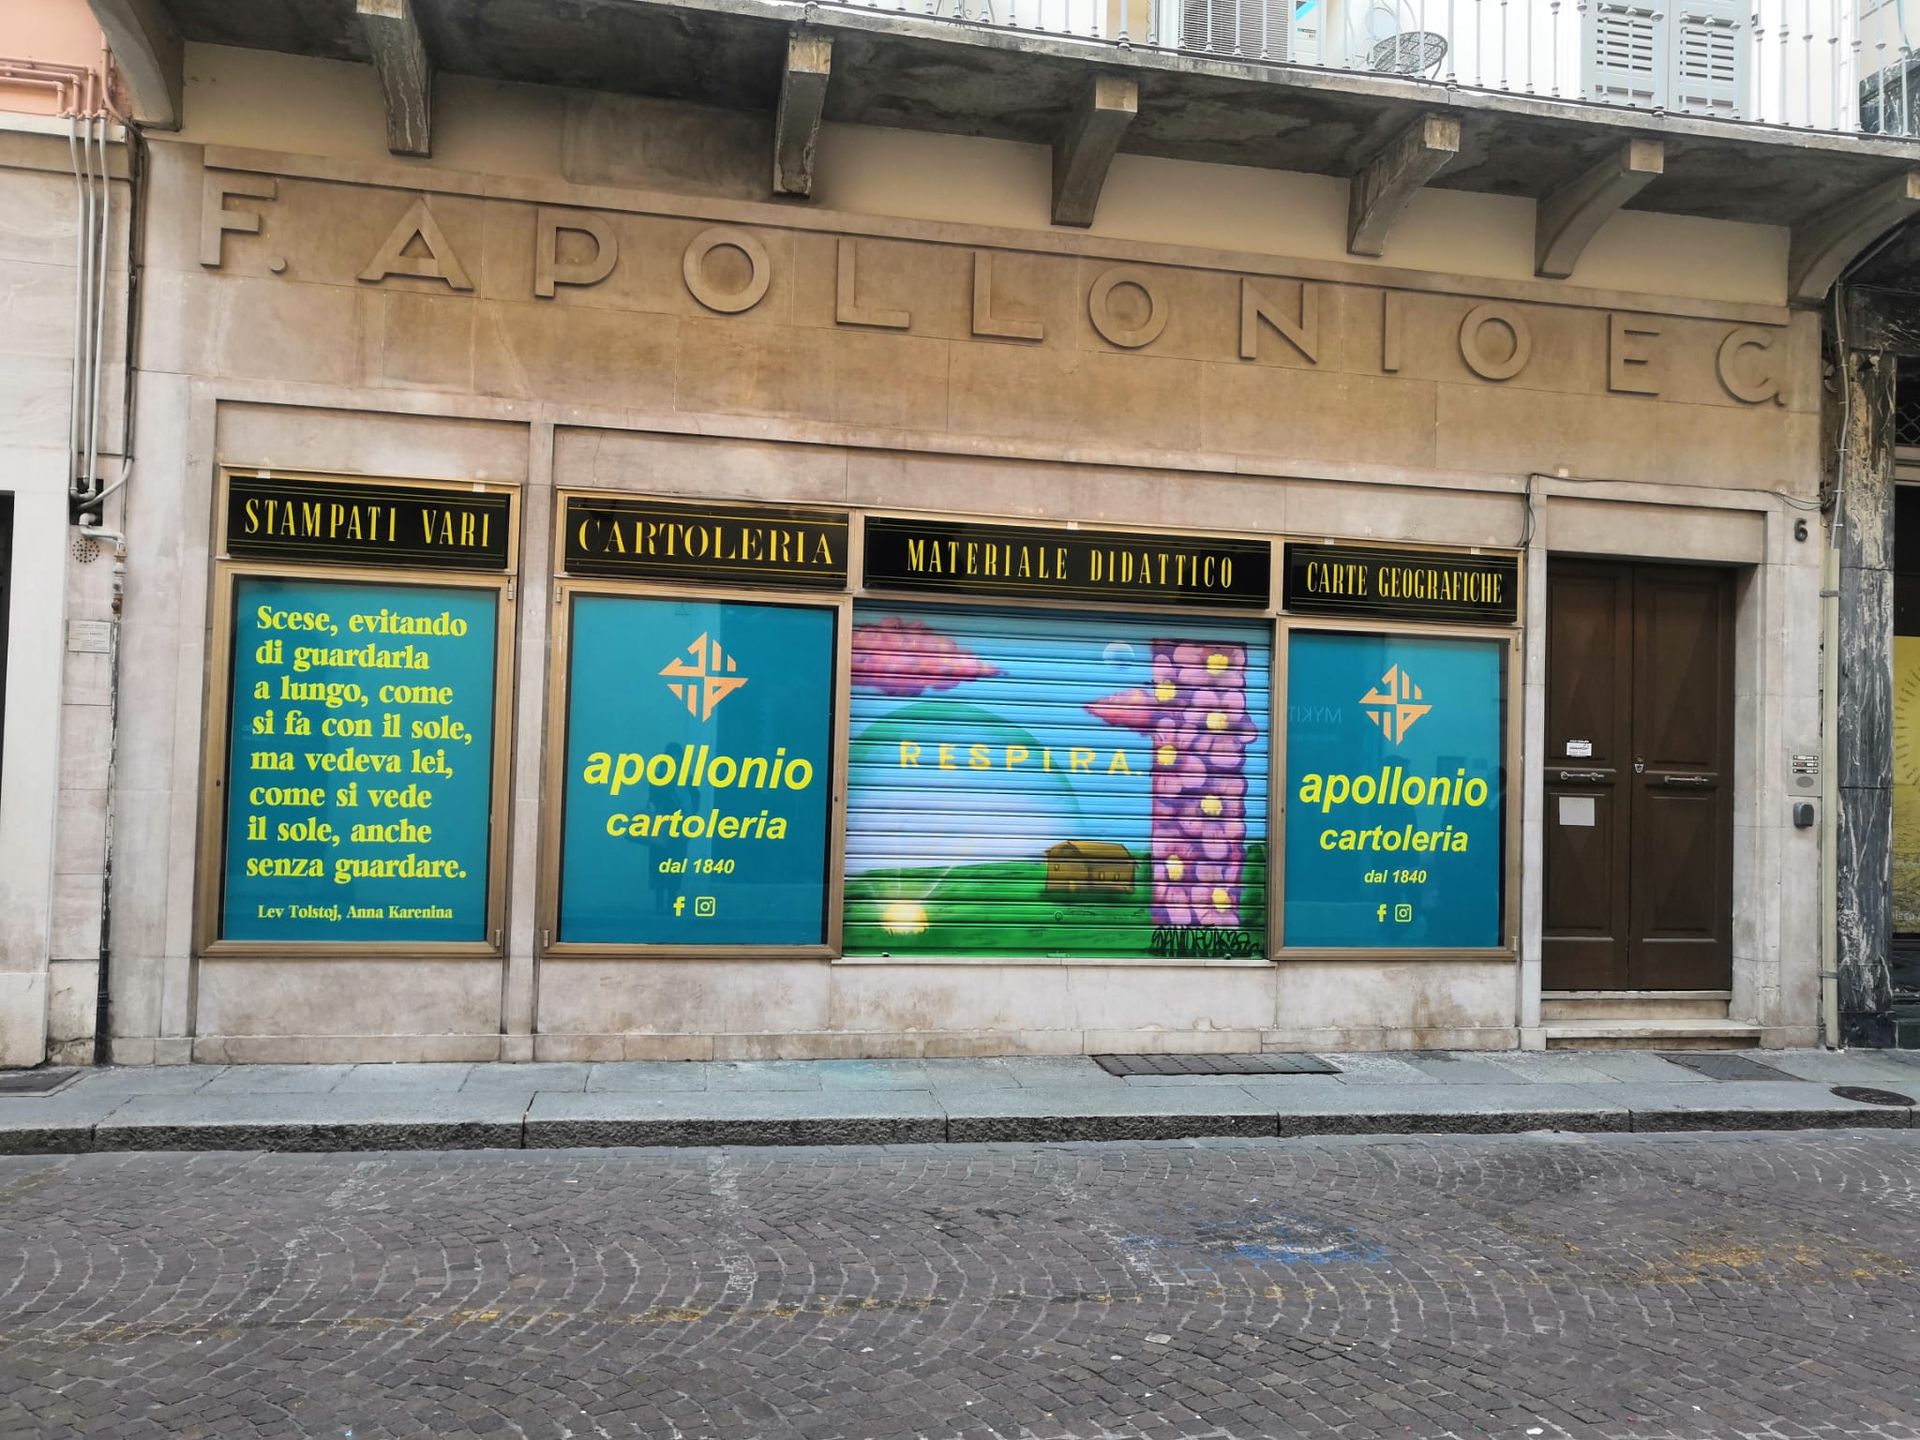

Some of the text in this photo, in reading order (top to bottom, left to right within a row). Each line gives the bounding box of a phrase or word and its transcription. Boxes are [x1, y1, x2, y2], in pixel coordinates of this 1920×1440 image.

[200, 171, 288, 276] F.
[245, 499, 489, 548] STAMPATI VARI
[1794, 518, 1808, 542] 6
[578, 518, 834, 565] CARTOLERIA
[908, 538, 1232, 588] MATERIALE DIDATTICO
[1307, 561, 1504, 604] CARTE GEOGRAFICHE
[257, 605, 468, 637] Scese, evitando
[255, 639, 430, 673] di guardarla
[254, 675, 453, 708] a lungo, come
[252, 709, 473, 744] si fa con il sole,
[251, 747, 453, 778] ma vedeva lei,
[583, 744, 814, 796] apollonio
[899, 741, 1143, 776] RESPIRA.
[249, 782, 433, 809] come si vede
[1299, 766, 1488, 814] apollonio
[247, 815, 432, 846] il sole, anche
[606, 808, 788, 840] cartoleria
[1319, 824, 1469, 852] cartoleria
[246, 853, 467, 884] senza guardare.
[659, 858, 735, 874] dal 1840
[1364, 870, 1427, 884] dal 1840
[258, 905, 453, 921] Lev Tolstoj, Anna Karenina
